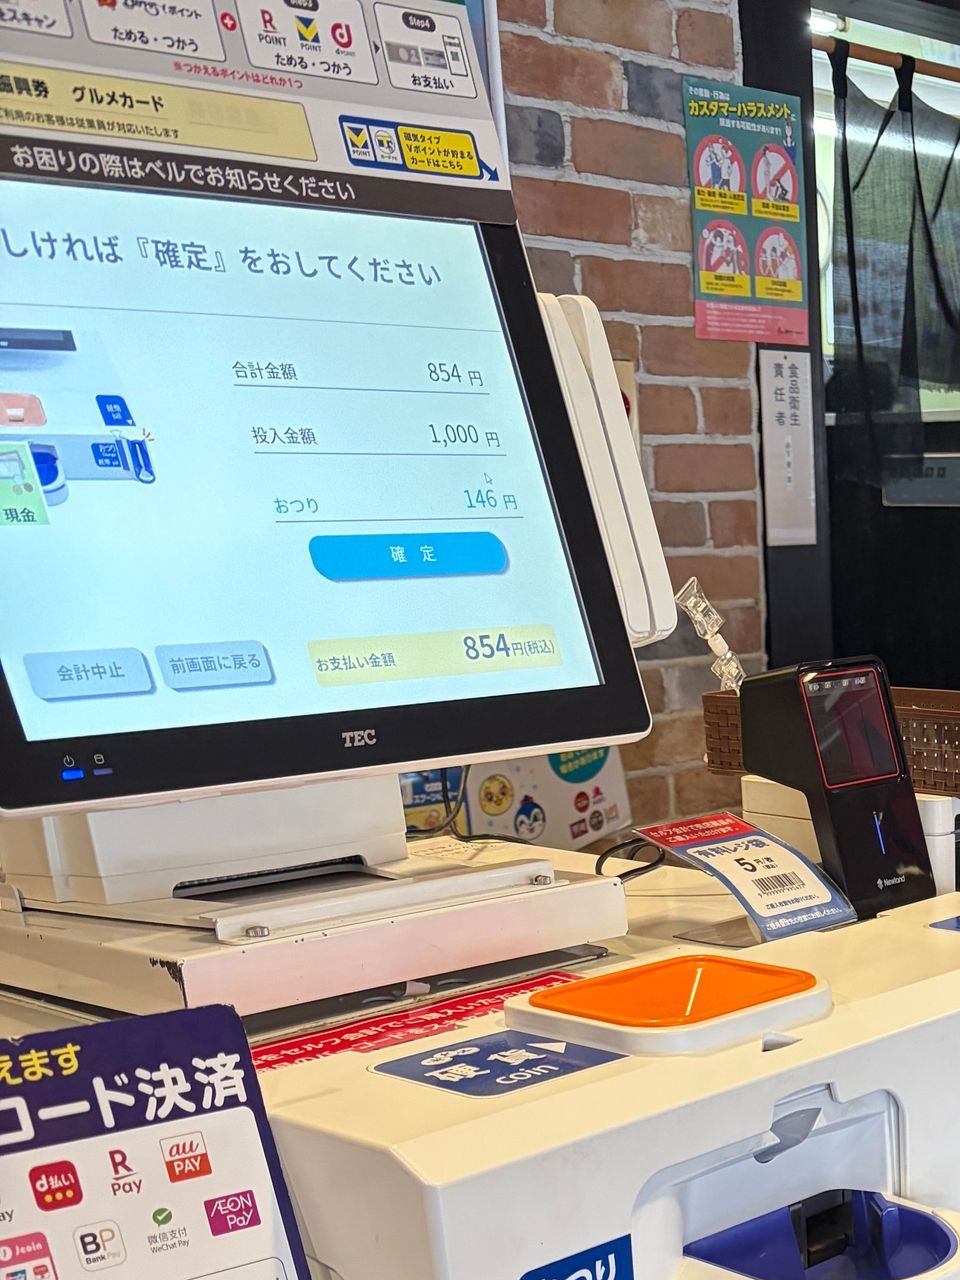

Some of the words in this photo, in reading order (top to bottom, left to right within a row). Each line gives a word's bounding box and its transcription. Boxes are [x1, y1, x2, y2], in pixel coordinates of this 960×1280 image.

[112, 26, 199, 52] ためる・つかう
[258, 33, 287, 47] POINT
[300, 43, 322, 53] POINT
[274, 52, 352, 76] ためる・つかう
[411, 73, 454, 90] お支払い
[72, 85, 165, 112] グルメカード
[403, 132, 441, 144] 磁気タイプ
[353, 149, 371, 158] POINT
[407, 144, 474, 160] Vポイントが貯まる
[12, 144, 356, 200] お困りの際はベルでお知らせください
[410, 157, 464, 171] カードはこちら
[2, 227, 442, 287] しければ『確定』をおしてください
[232, 361, 297, 381] 合計金額
[428, 363, 462, 384] 854
[468, 371, 483, 387] 円
[252, 426, 318, 446] 投入金額
[429, 424, 479, 446] 1,000
[486, 431, 501, 448] 円
[274, 497, 318, 515] おつり
[464, 489, 497, 509] 146
[503, 494, 518, 511] 円
[2, 508, 37, 524] 現金
[56, 661, 125, 683] 会計中止
[169, 653, 262, 675] 前画面に戻る
[316, 652, 397, 674] お支払い金額
[342, 729, 377, 748] TEC
[883, 875, 905, 886] Newland
[0, 1042, 81, 1085] えます
[496, 1062, 559, 1086] coin
[0, 1052, 248, 1146] コード決済
[169, 1140, 199, 1158] au
[108, 1149, 135, 1175] R
[173, 1157, 203, 1176] PAY
[36, 1173, 75, 1192] d払い
[111, 1178, 143, 1197] Pay
[226, 1209, 254, 1230] Pay
[80, 1228, 116, 1256] BP
[148, 1226, 188, 1246] 微信支付
[150, 1240, 178, 1255] WeChat
[177, 1236, 191, 1251] Pay
[86, 1254, 106, 1265] Bank
